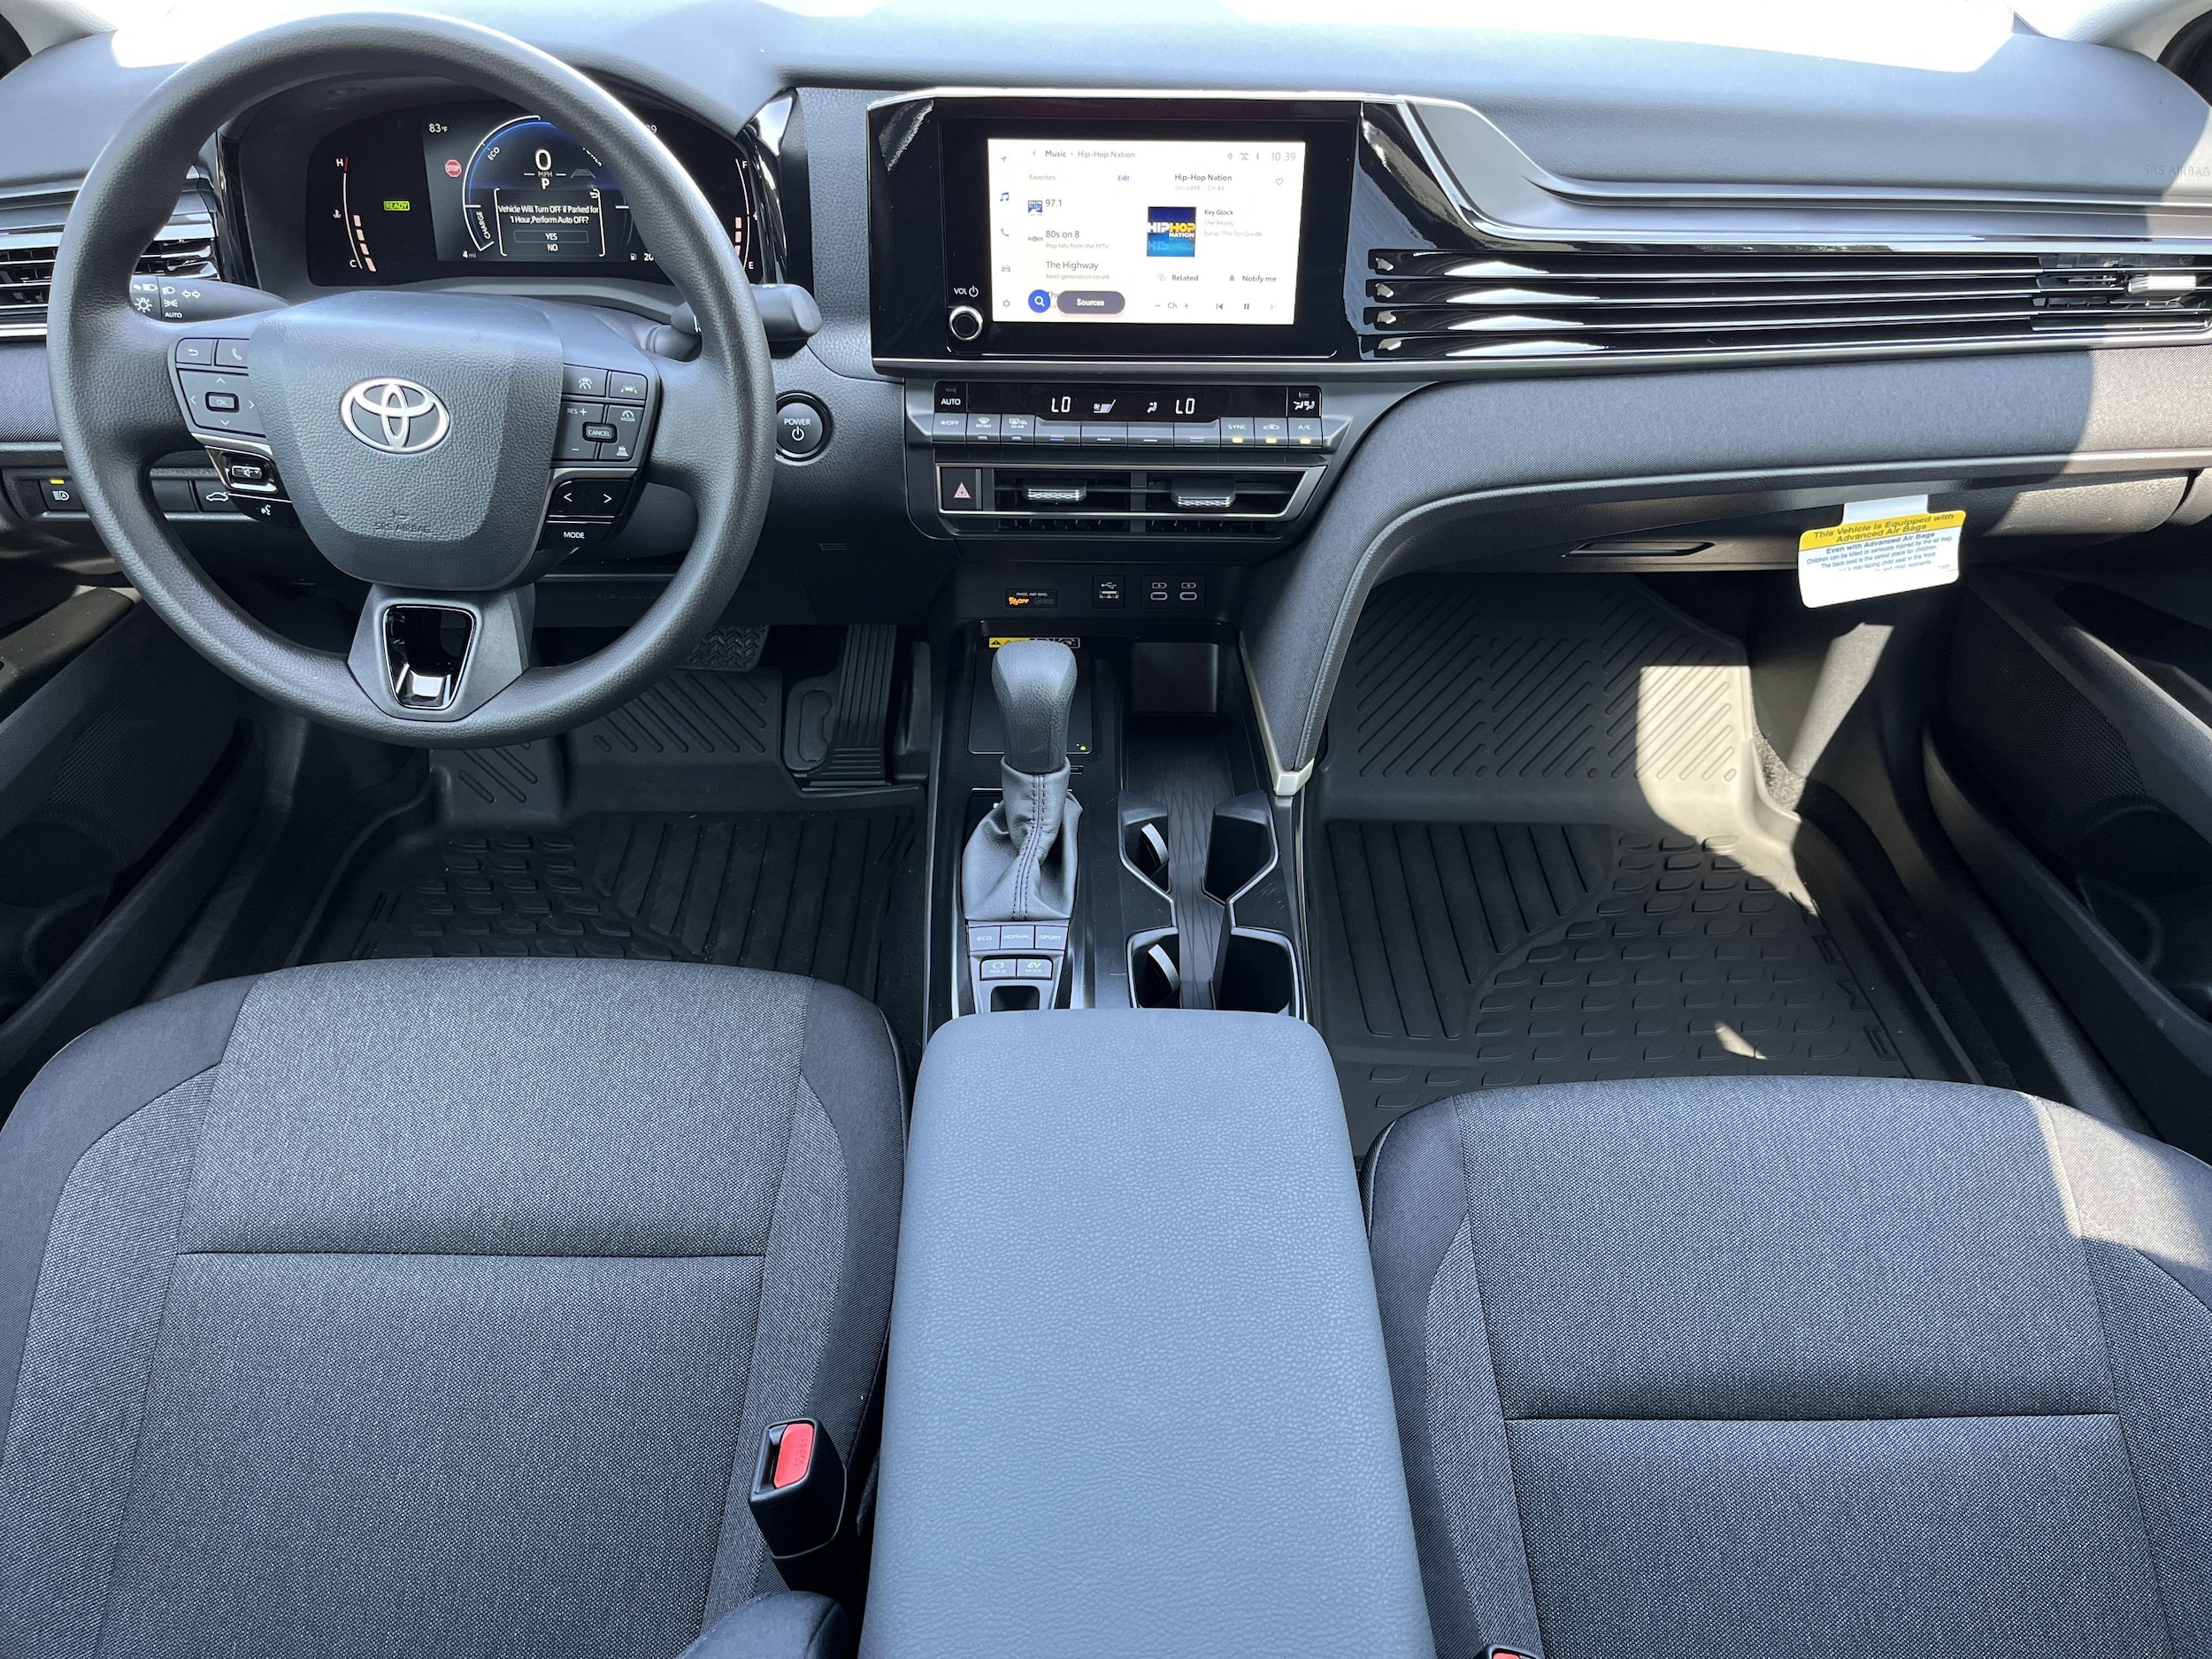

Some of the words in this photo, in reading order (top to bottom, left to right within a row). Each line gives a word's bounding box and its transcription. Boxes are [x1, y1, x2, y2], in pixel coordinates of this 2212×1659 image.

[488, 147, 500, 161] ECO
[535, 149, 552, 171] 0
[1078, 150, 1109, 159] Hip-Hop
[446, 164, 460, 173] STOP
[2144, 165, 2164, 175] SRS
[2169, 165, 2210, 177] AIRBAG
[541, 178, 550, 189] P
[1174, 173, 1206, 182] Hip-Hop
[475, 211, 491, 240] CHARGE
[349, 259, 357, 268] C
[1063, 261, 1099, 271] Highway
[1241, 275, 1264, 284] Notify
[1051, 396, 1071, 413] LO
[1175, 397, 1195, 415] LO
[1814, 530, 1834, 539] This
[1837, 525, 1871, 535] Vehicle
[1885, 516, 1932, 530] Equipped
[1932, 513, 1955, 522] with
[1836, 530, 1884, 543] Advanced
[1886, 526, 1901, 535] Air
[1903, 524, 1927, 534] Bags
[1863, 536, 1901, 548] Advanced
[1807, 556, 1829, 565] Children
[1870, 544, 1894, 554] seriously
[794, 1438, 808, 1467] PRESS
